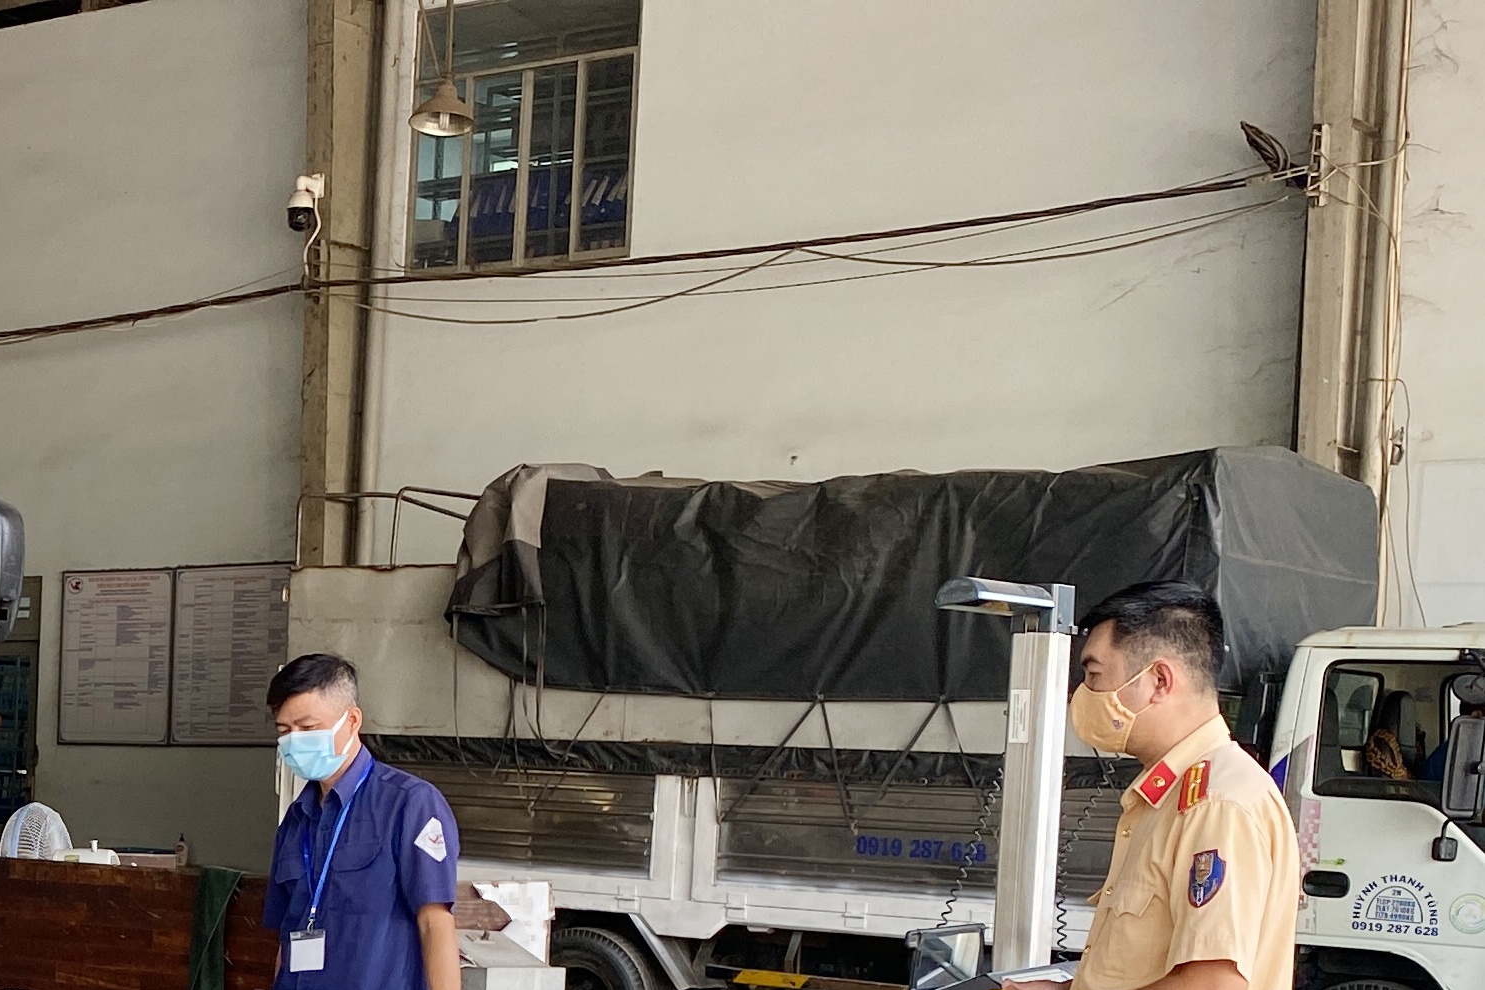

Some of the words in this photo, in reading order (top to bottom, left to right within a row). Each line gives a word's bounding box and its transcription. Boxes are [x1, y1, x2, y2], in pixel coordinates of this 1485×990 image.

[856, 835, 902, 857] 0919
[909, 840, 943, 859] 287
[1380, 874, 1425, 892] THANH
[1352, 921, 1382, 932] 0919
[1387, 923, 1410, 934] 287
[1415, 926, 1439, 937] 628
